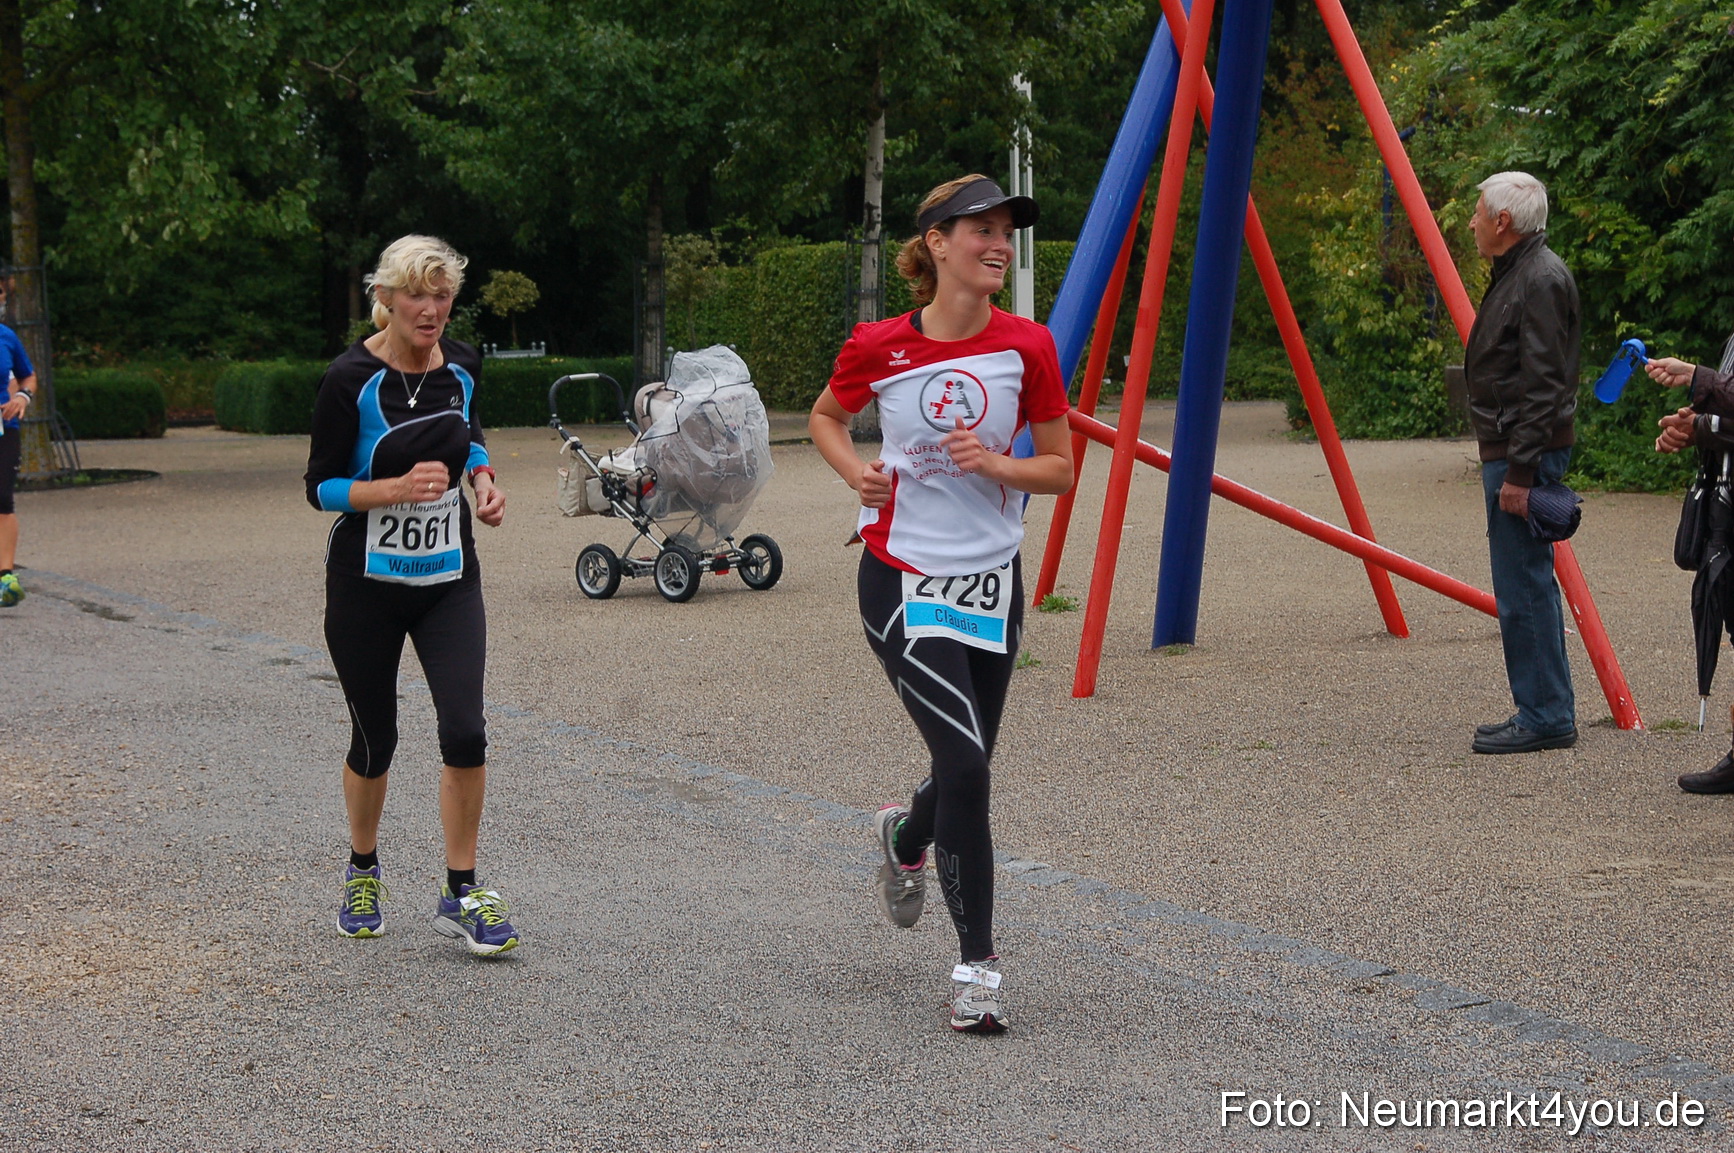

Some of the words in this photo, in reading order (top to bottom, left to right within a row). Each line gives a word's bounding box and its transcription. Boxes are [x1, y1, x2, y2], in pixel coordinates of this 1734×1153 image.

[378, 512, 451, 551] 2661
[388, 557, 446, 574] Waltraud
[934, 608, 979, 634] Claudia
